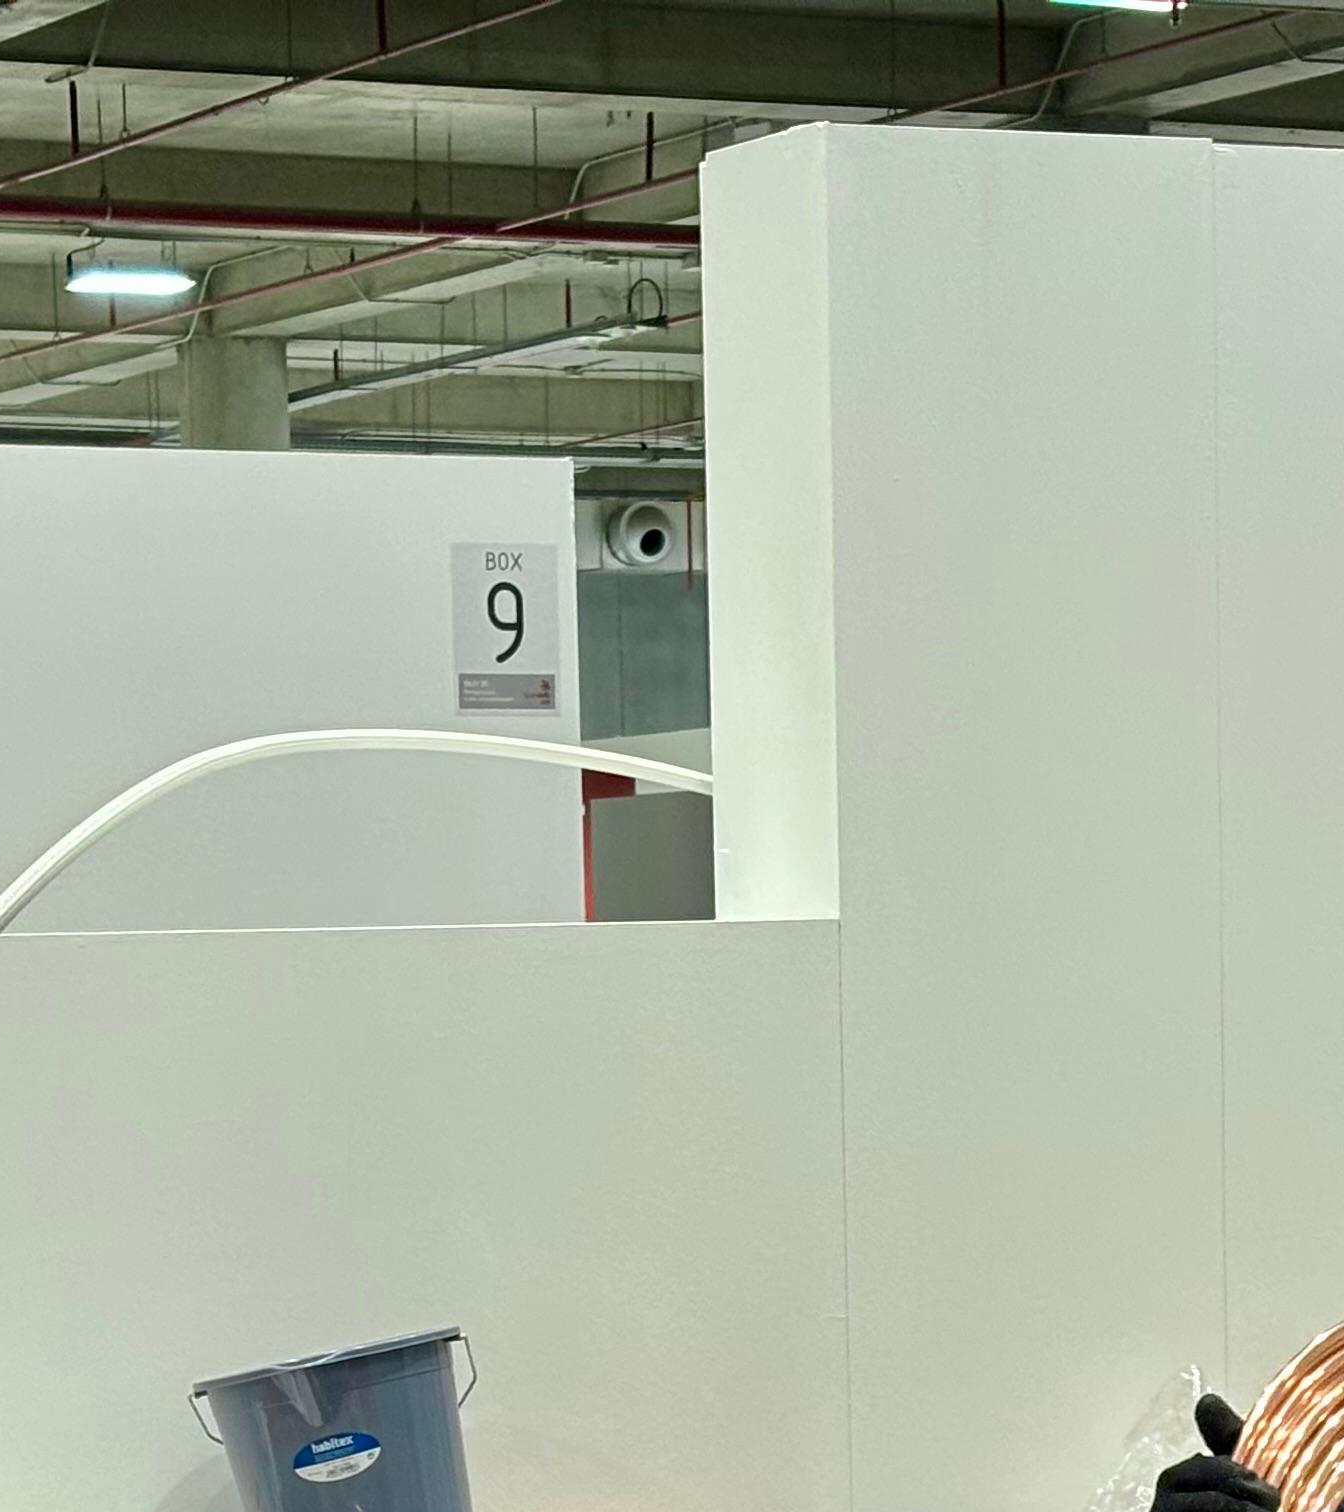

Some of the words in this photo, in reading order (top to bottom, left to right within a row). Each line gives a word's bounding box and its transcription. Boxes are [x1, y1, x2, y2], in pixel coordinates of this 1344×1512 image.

[485, 551, 523, 571] BOX
[487, 581, 524, 663] 9
[311, 1435, 354, 1454] habitex
